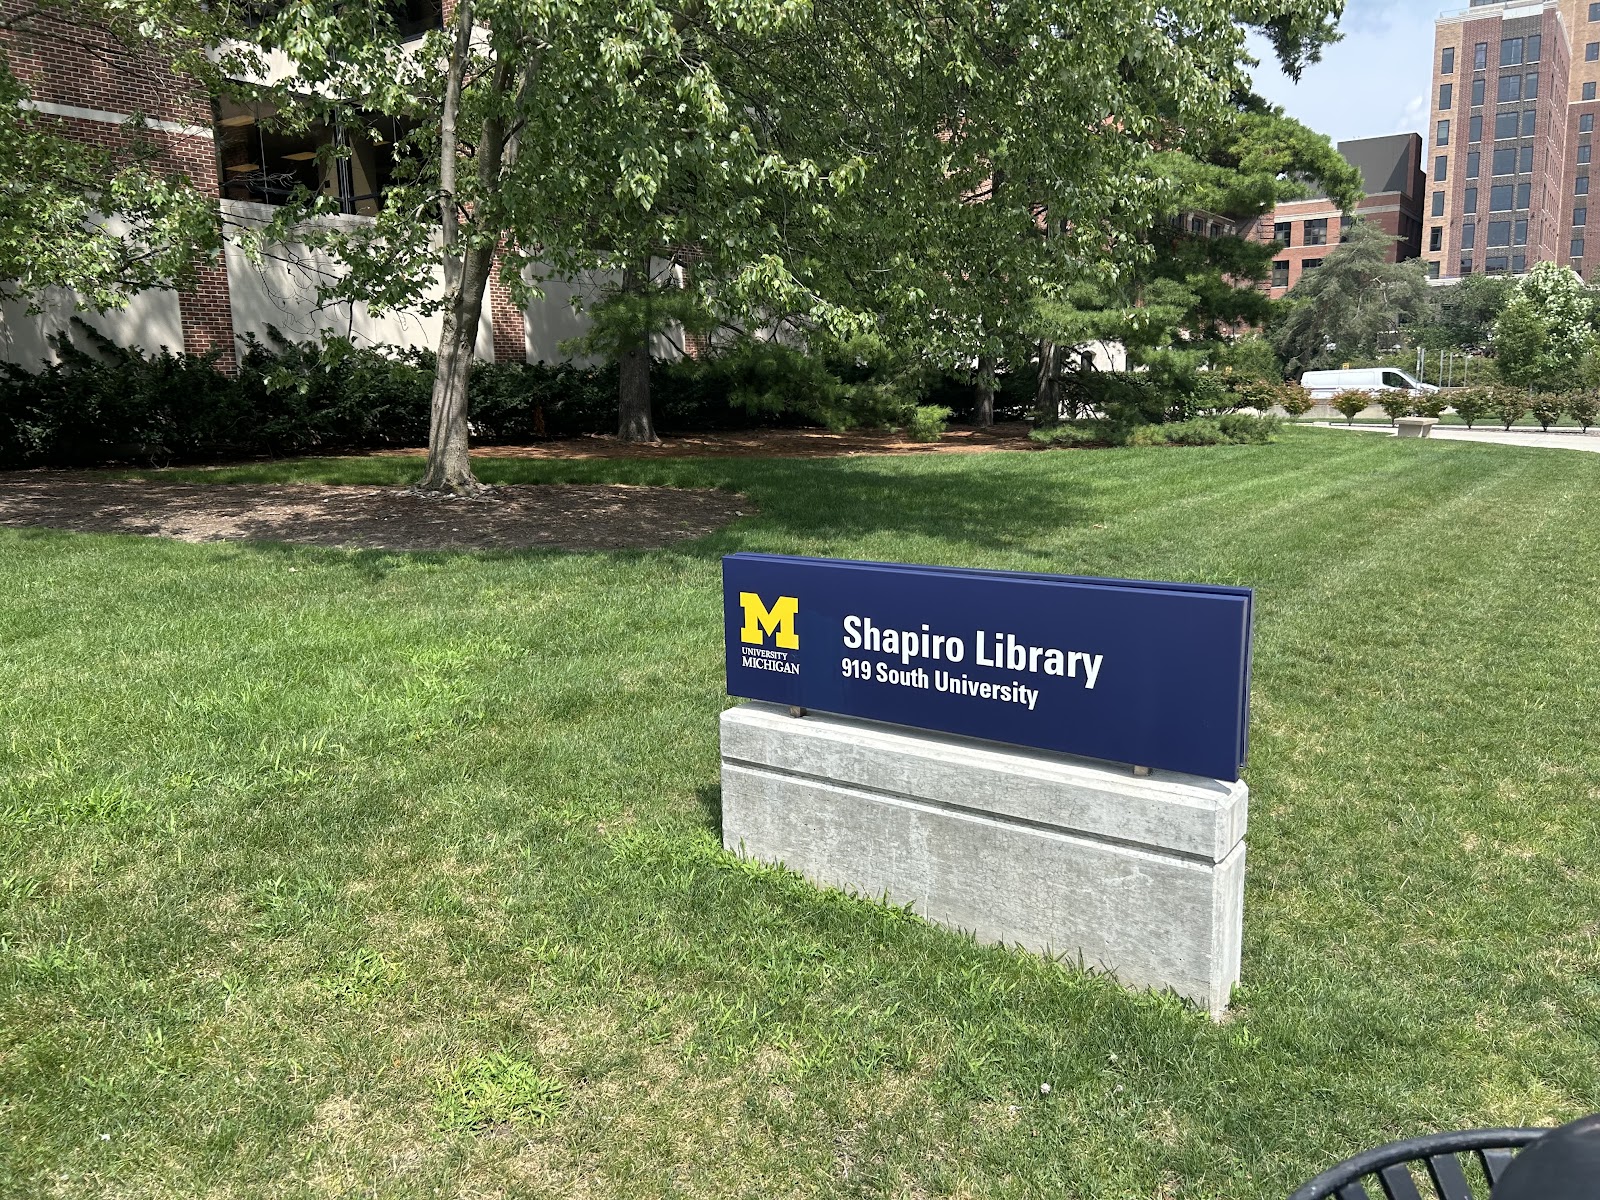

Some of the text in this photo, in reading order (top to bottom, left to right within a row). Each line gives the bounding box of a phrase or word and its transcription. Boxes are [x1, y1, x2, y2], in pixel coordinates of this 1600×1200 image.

[740, 592, 799, 650] M
[741, 647, 788, 661] UNIVERSITY
[742, 656, 800, 675] MICHIGAN
[844, 616, 1104, 689] Shapiro Library
[841, 658, 1038, 711] 919 South University
